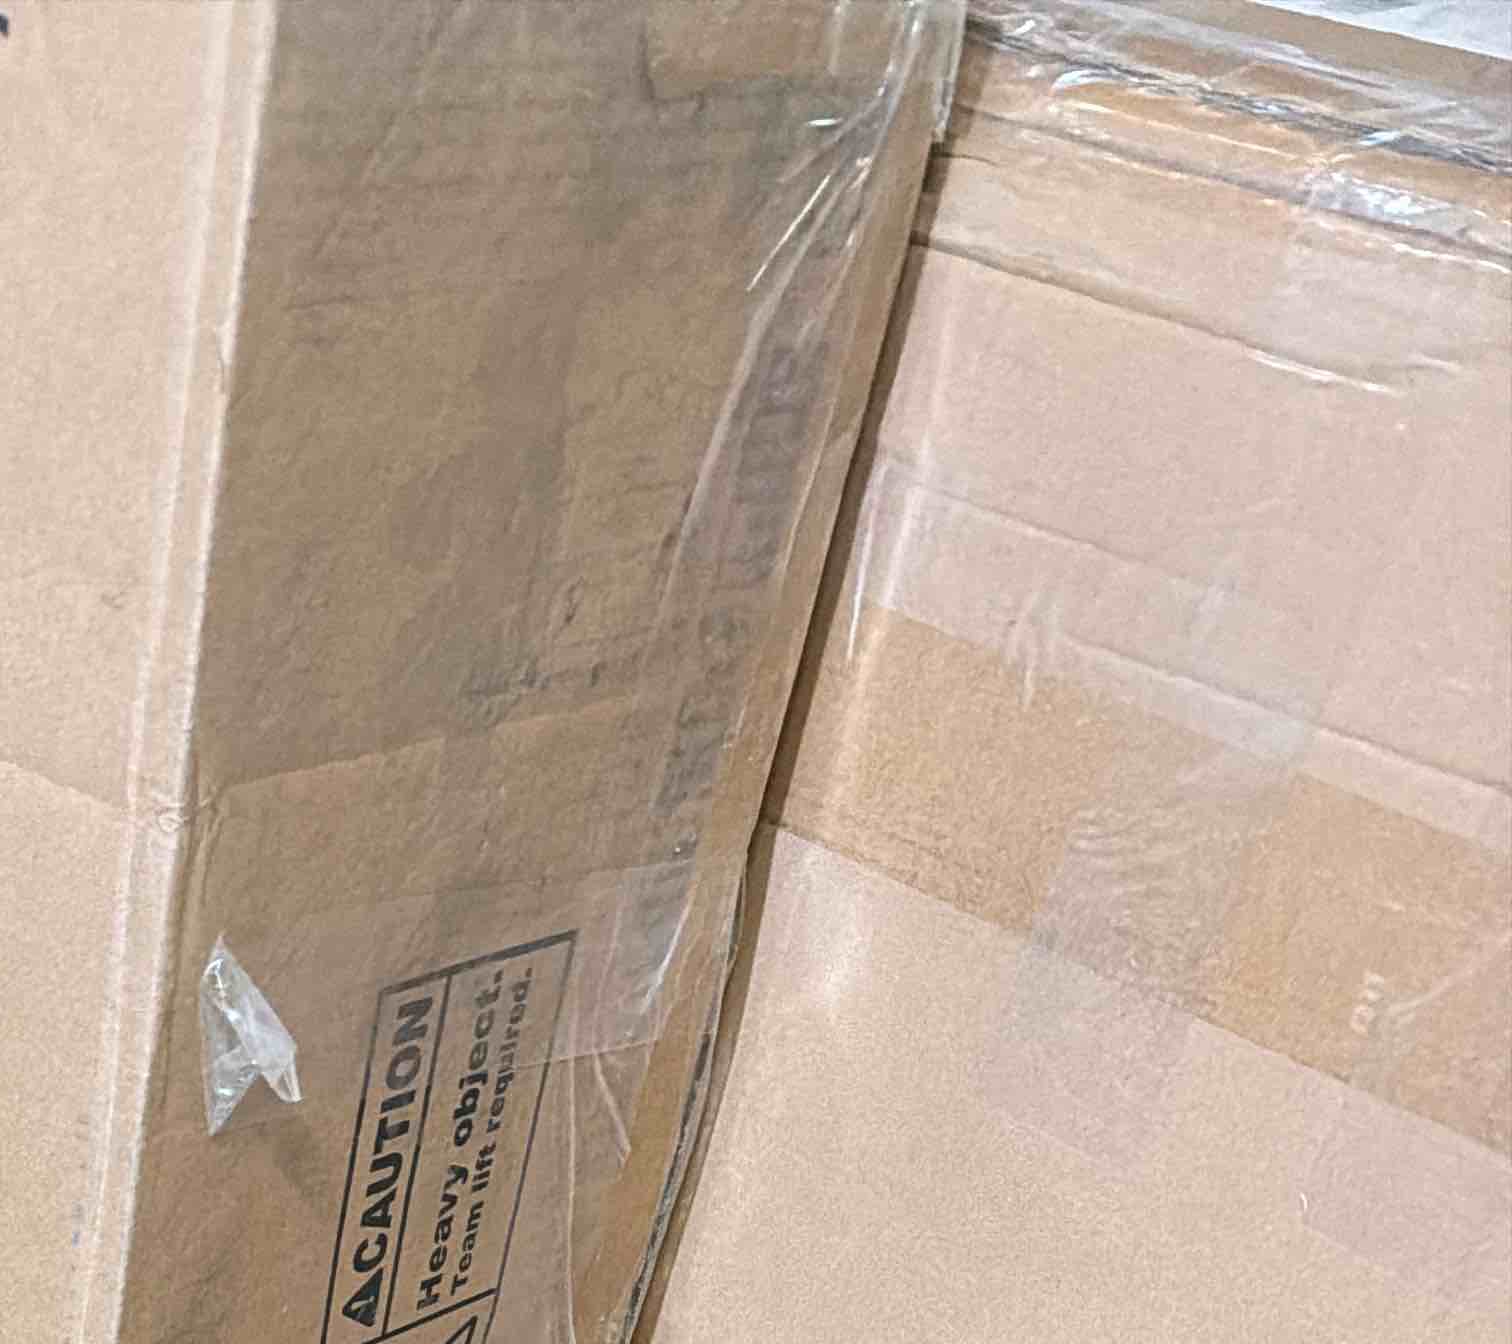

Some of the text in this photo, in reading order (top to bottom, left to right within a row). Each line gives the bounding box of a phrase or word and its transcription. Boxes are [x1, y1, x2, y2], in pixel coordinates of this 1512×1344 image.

[353, 996, 434, 1273] CAUTION
[416, 968, 505, 1311] Heavy object.
[449, 1200, 485, 1297] Team
[470, 1141, 497, 1195] lift
